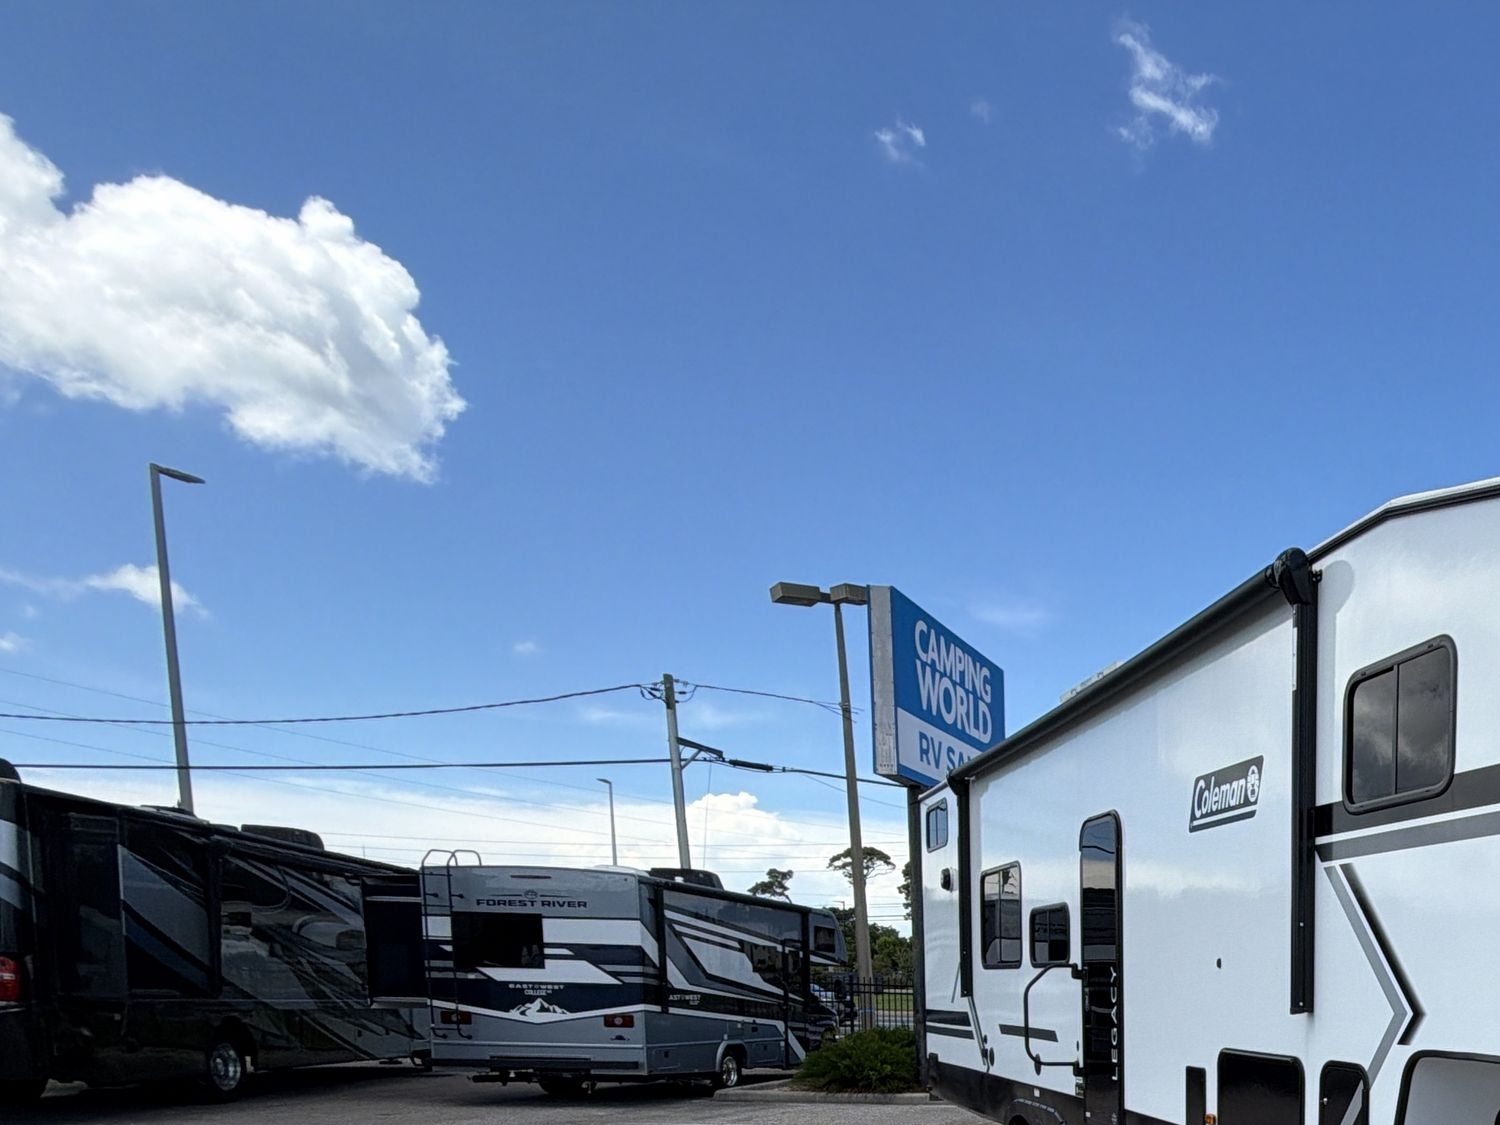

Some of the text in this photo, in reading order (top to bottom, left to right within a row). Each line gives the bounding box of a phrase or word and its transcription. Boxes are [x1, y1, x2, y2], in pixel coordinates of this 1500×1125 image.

[914, 619, 992, 704] CAMPING
[915, 658, 993, 744] WORLD
[918, 730, 973, 772] RV SA
[1194, 775, 1246, 818] Coleman
[476, 898, 587, 908] FOREST RIVER
[1109, 966, 1118, 1081] LEGACY
